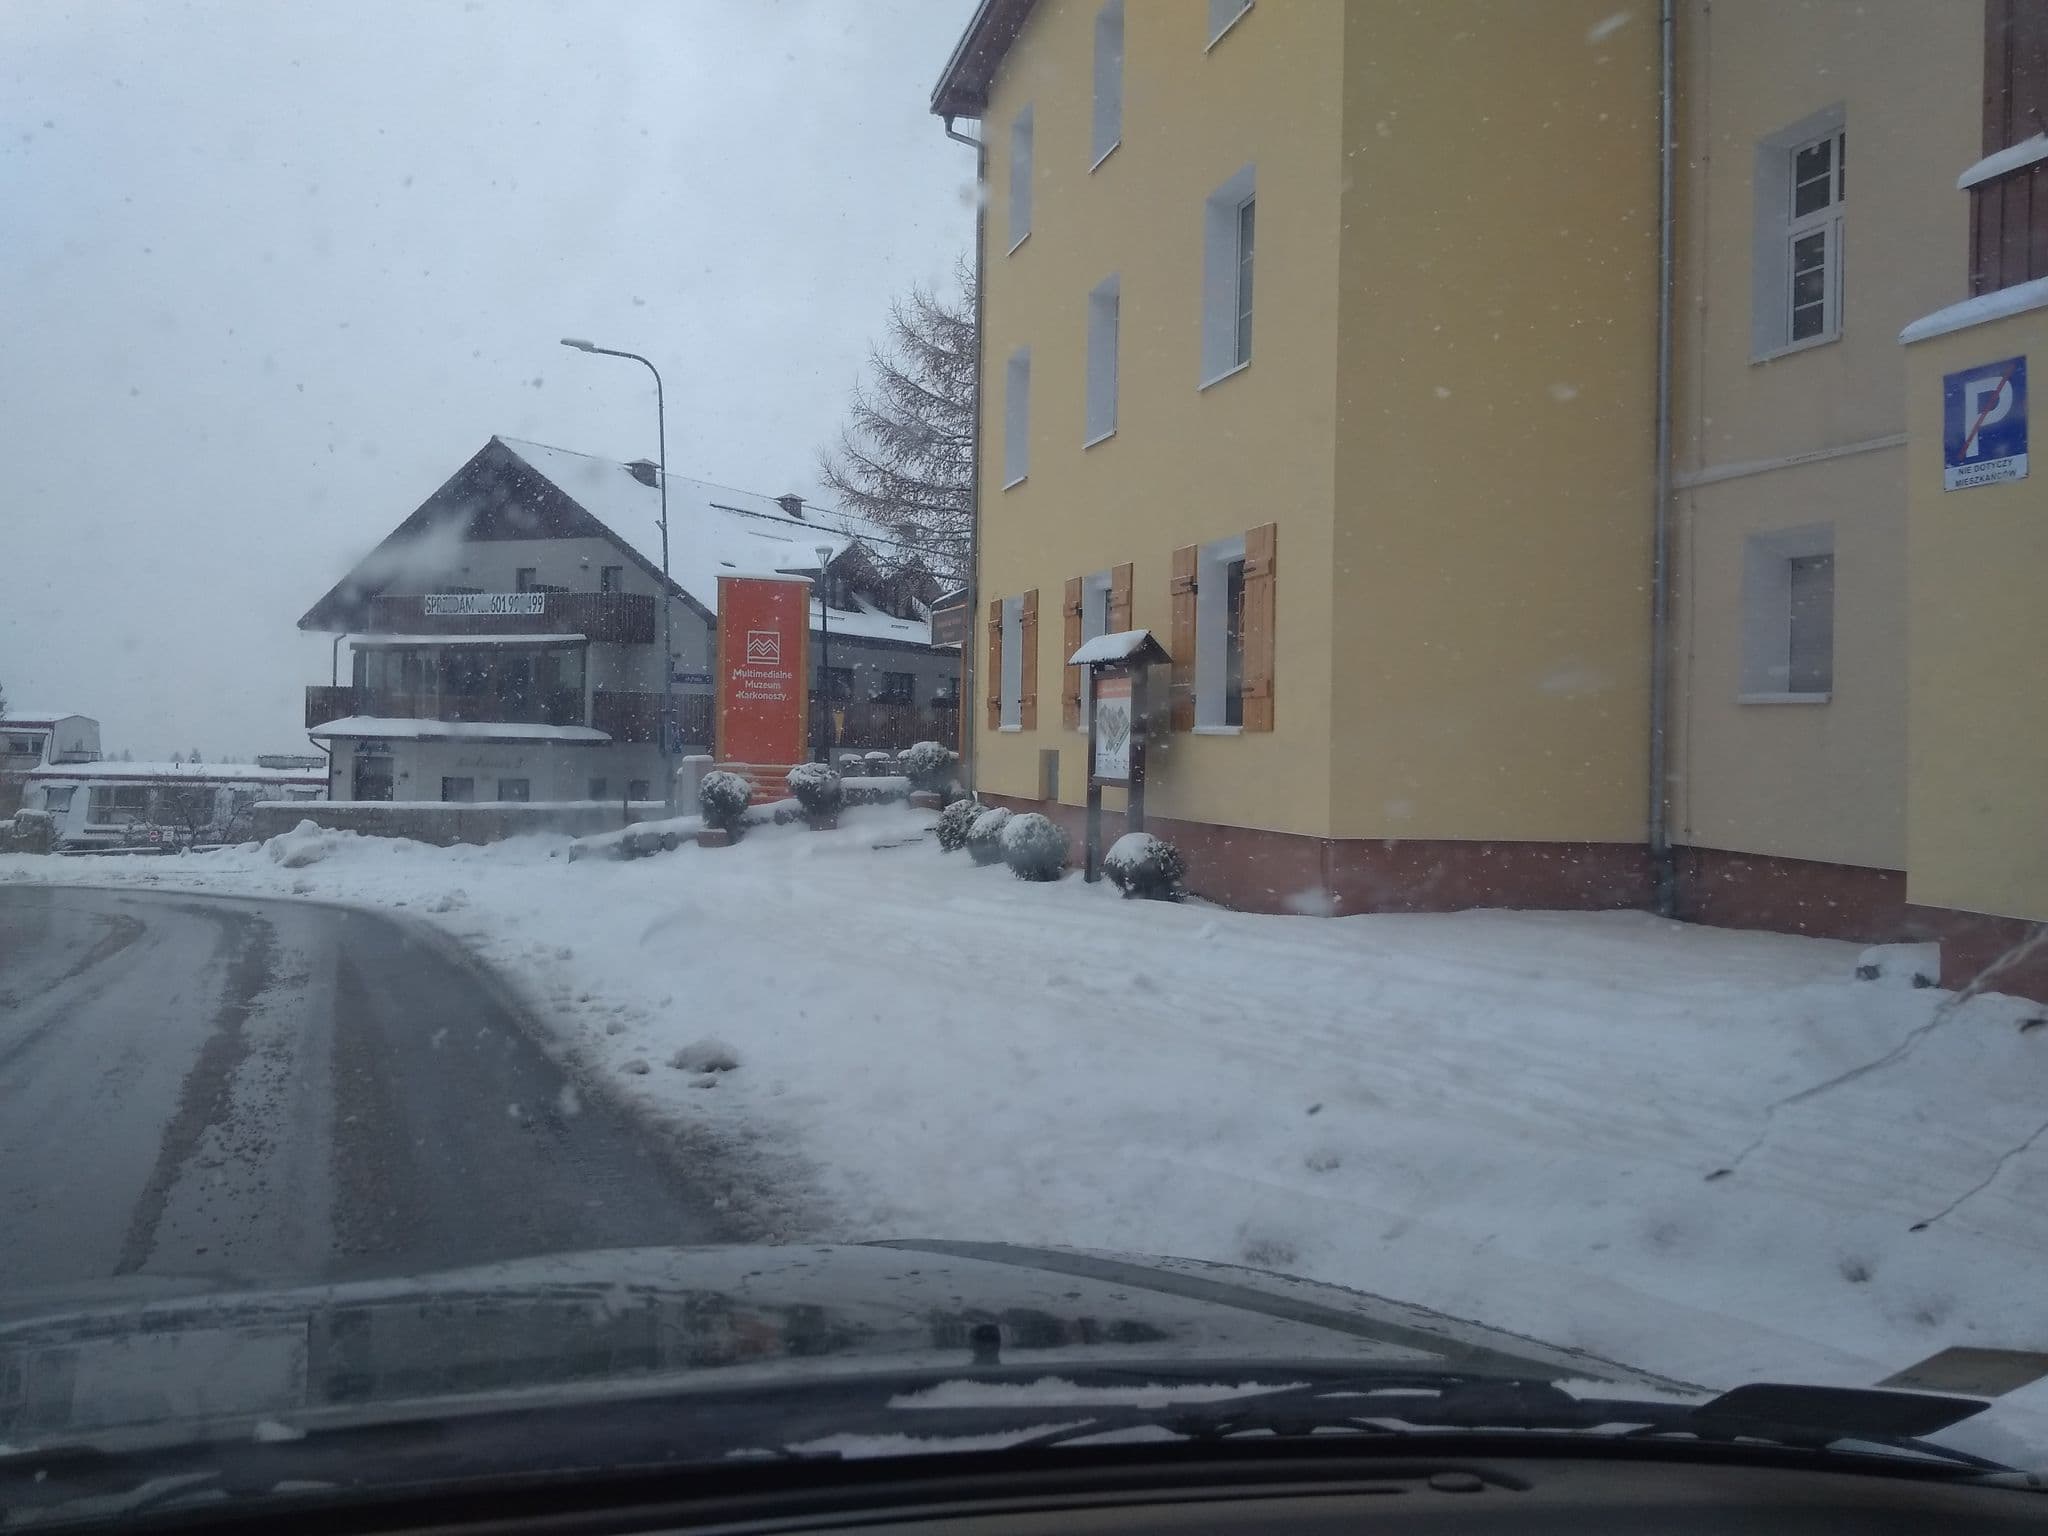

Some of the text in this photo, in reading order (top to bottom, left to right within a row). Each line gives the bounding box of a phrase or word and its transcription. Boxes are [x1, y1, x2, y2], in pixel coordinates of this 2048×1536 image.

[1965, 376, 2013, 458] P
[1958, 459, 2013, 475] NIE DOTYCZY
[490, 595, 506, 613] 601
[745, 680, 781, 689] Muzeum
[737, 690, 787, 701] Karkonoszy
